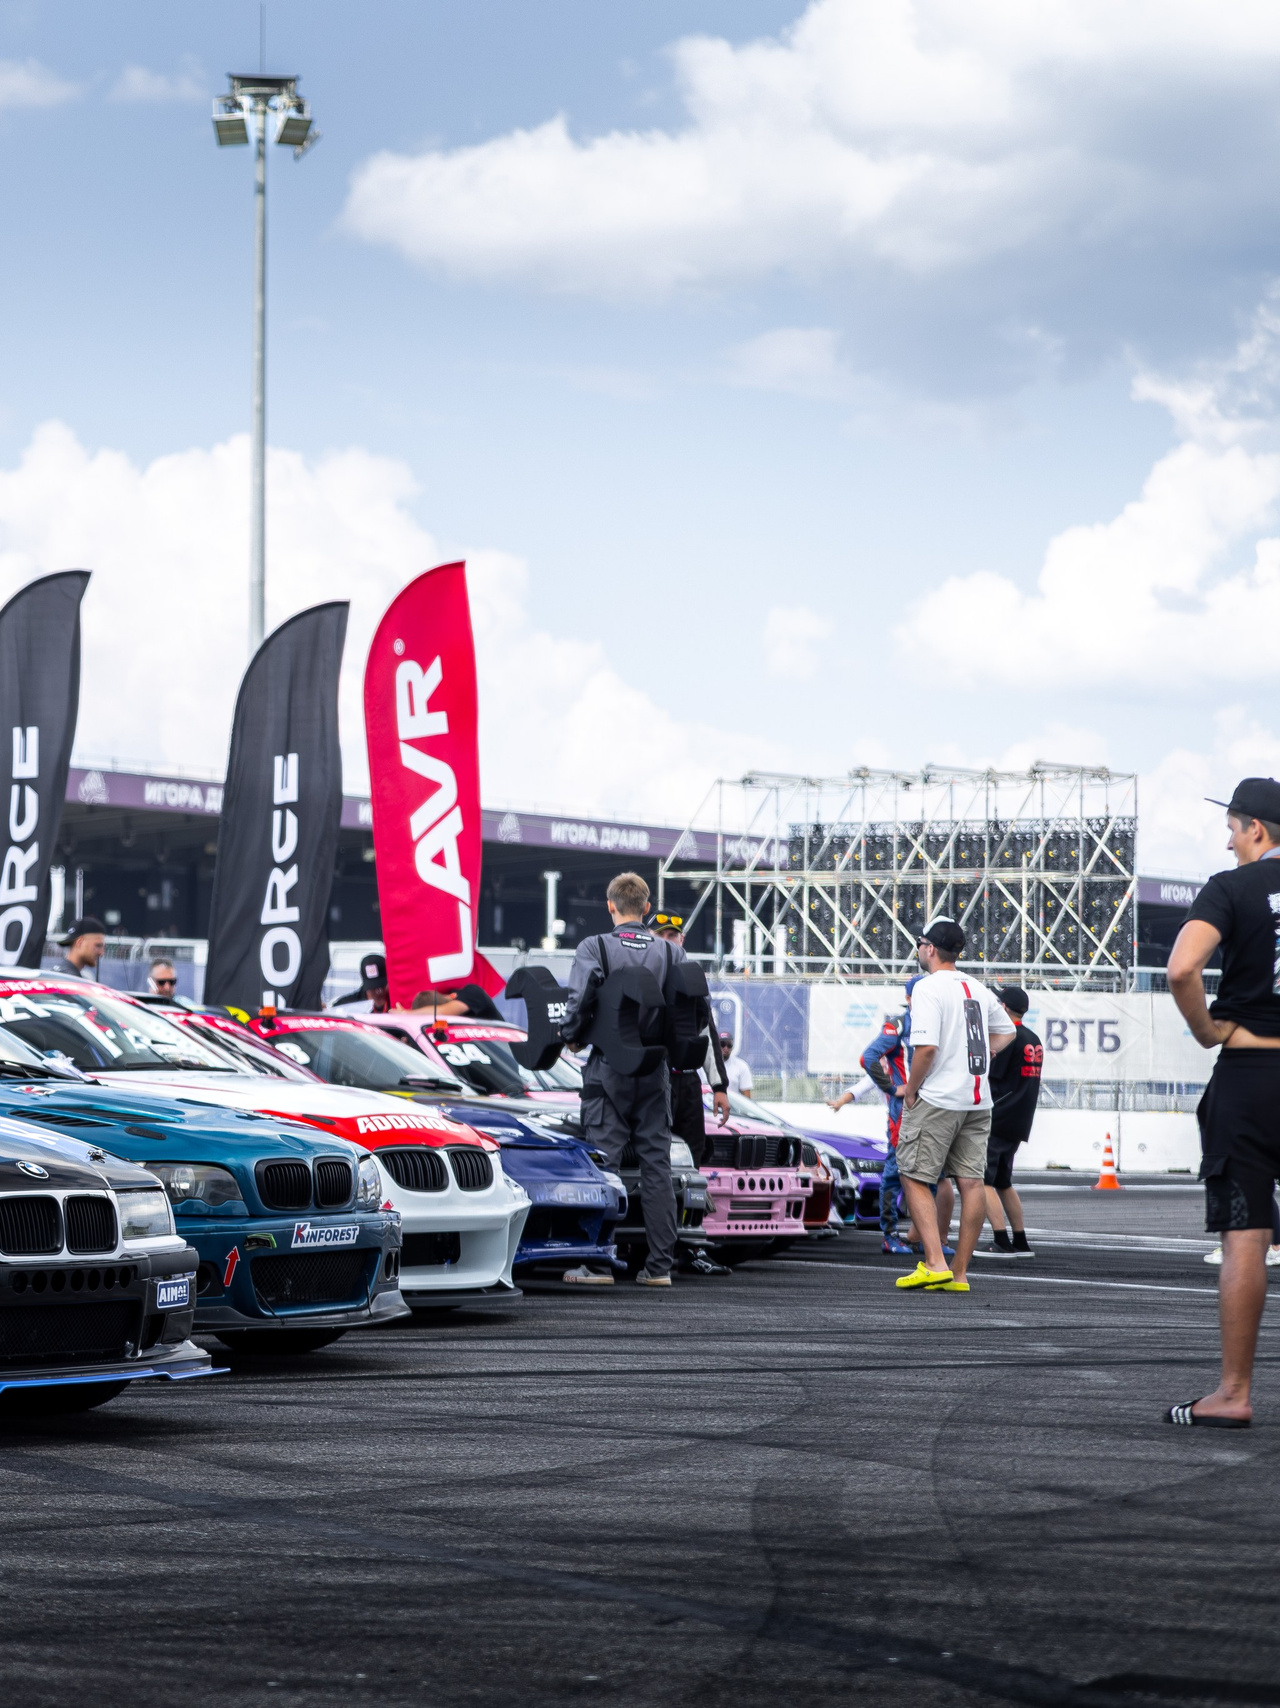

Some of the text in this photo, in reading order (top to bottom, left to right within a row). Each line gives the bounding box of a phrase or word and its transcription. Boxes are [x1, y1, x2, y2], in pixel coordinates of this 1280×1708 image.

[395, 655, 474, 983] LAVR
[1045, 1018, 1121, 1053] ВТБ
[437, 1043, 491, 1066] 34
[357, 1115, 461, 1134] ADDINOL
[293, 1224, 358, 1244] KINFOREST
[158, 1285, 188, 1303] AIMOL
